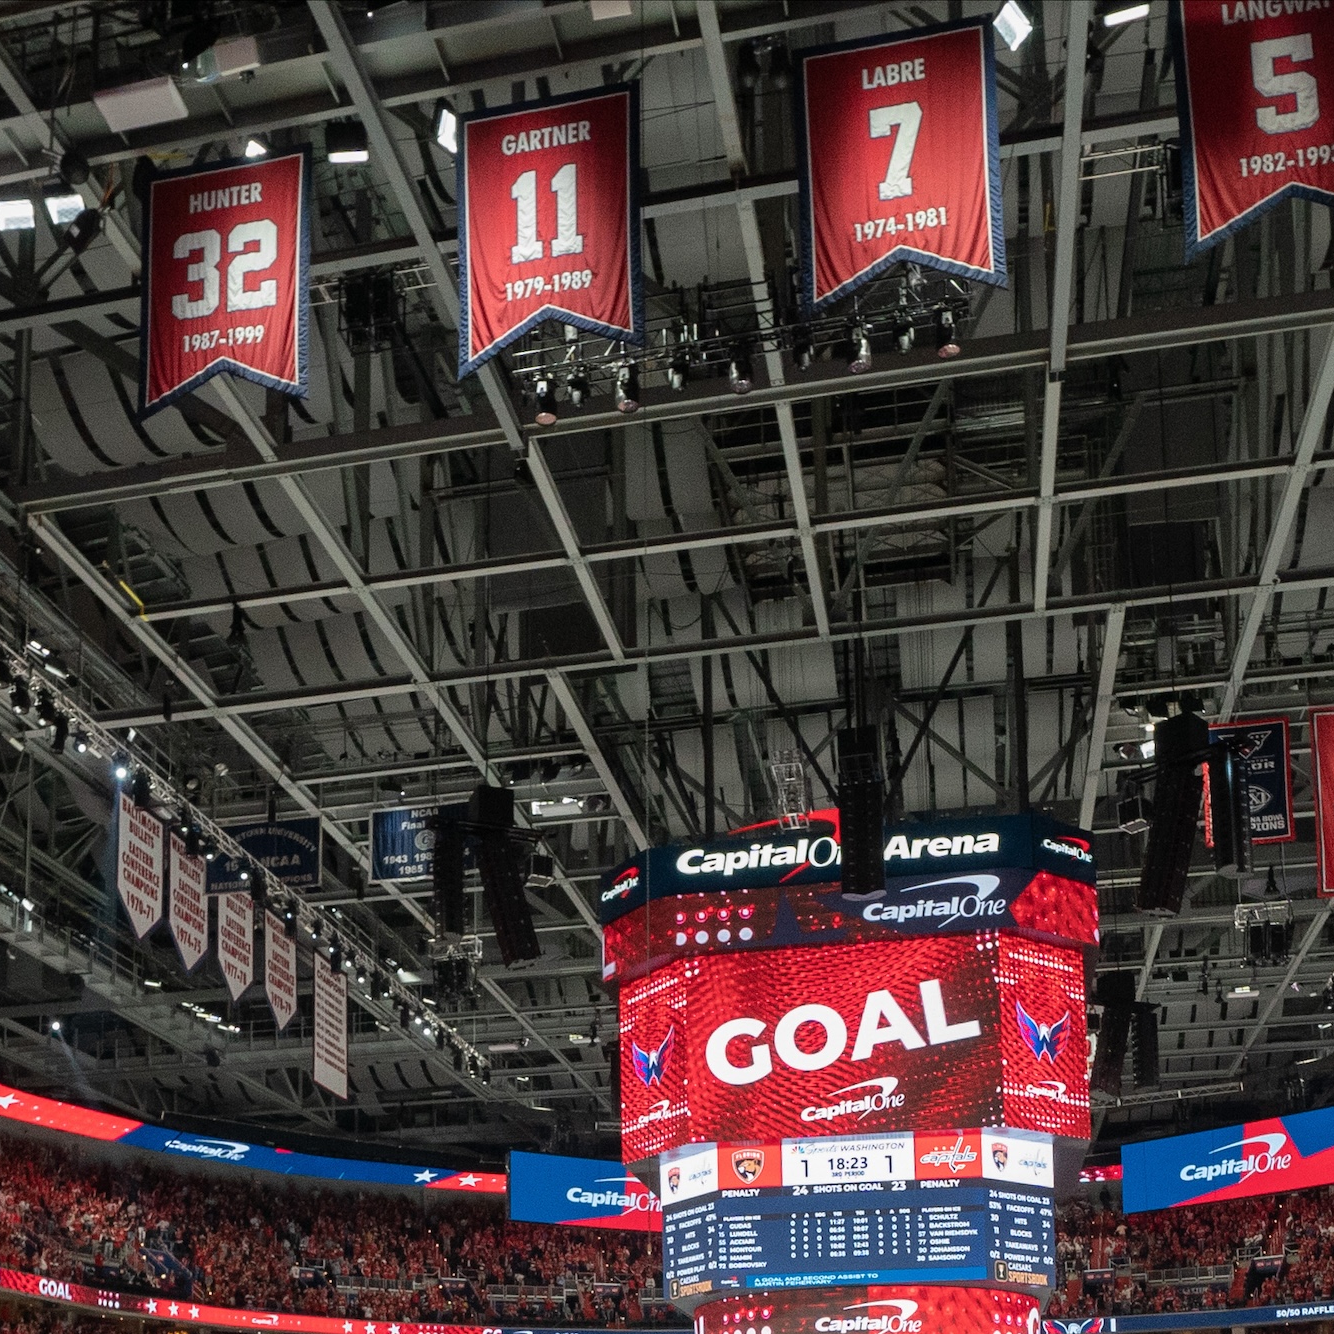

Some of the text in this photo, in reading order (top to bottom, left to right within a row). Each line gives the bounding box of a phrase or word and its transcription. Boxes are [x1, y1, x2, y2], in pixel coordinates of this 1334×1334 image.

[861, 58, 926, 90] LABRE
[1250, 33, 1322, 134] 5
[501, 121, 591, 157] GARTNER
[869, 101, 924, 201] 7
[188, 181, 263, 215] HUNTER
[511, 164, 584, 265] 11
[854, 208, 949, 243] 1974-1981
[172, 219, 277, 321] 32
[505, 270, 592, 303] 1979-1989
[182, 325, 265, 355] 1987-1999
[129, 819, 155, 850] BULLETS
[401, 820, 426, 831] Final
[128, 840, 154, 870] EASTERN
[383, 854, 408, 865] 1943
[883, 832, 1000, 861] Arena
[122, 851, 160, 889] CONFERENCE
[123, 867, 158, 902] CHAMPIONS
[178, 858, 201, 885] BULLETS
[705, 978, 983, 1087] GOAL
[840, 1142, 905, 1152] WASHINGTON
[800, 1155, 894, 1178] 1 18:23 1
[722, 1189, 760, 1198] PENALTY
[792, 1180, 907, 1196] 24 SHOTS ON GOAL 23
[920, 1179, 960, 1189] PENALTY
[39, 1279, 72, 1300] GOAL
[1276, 1308, 1299, 1318] 50/50
